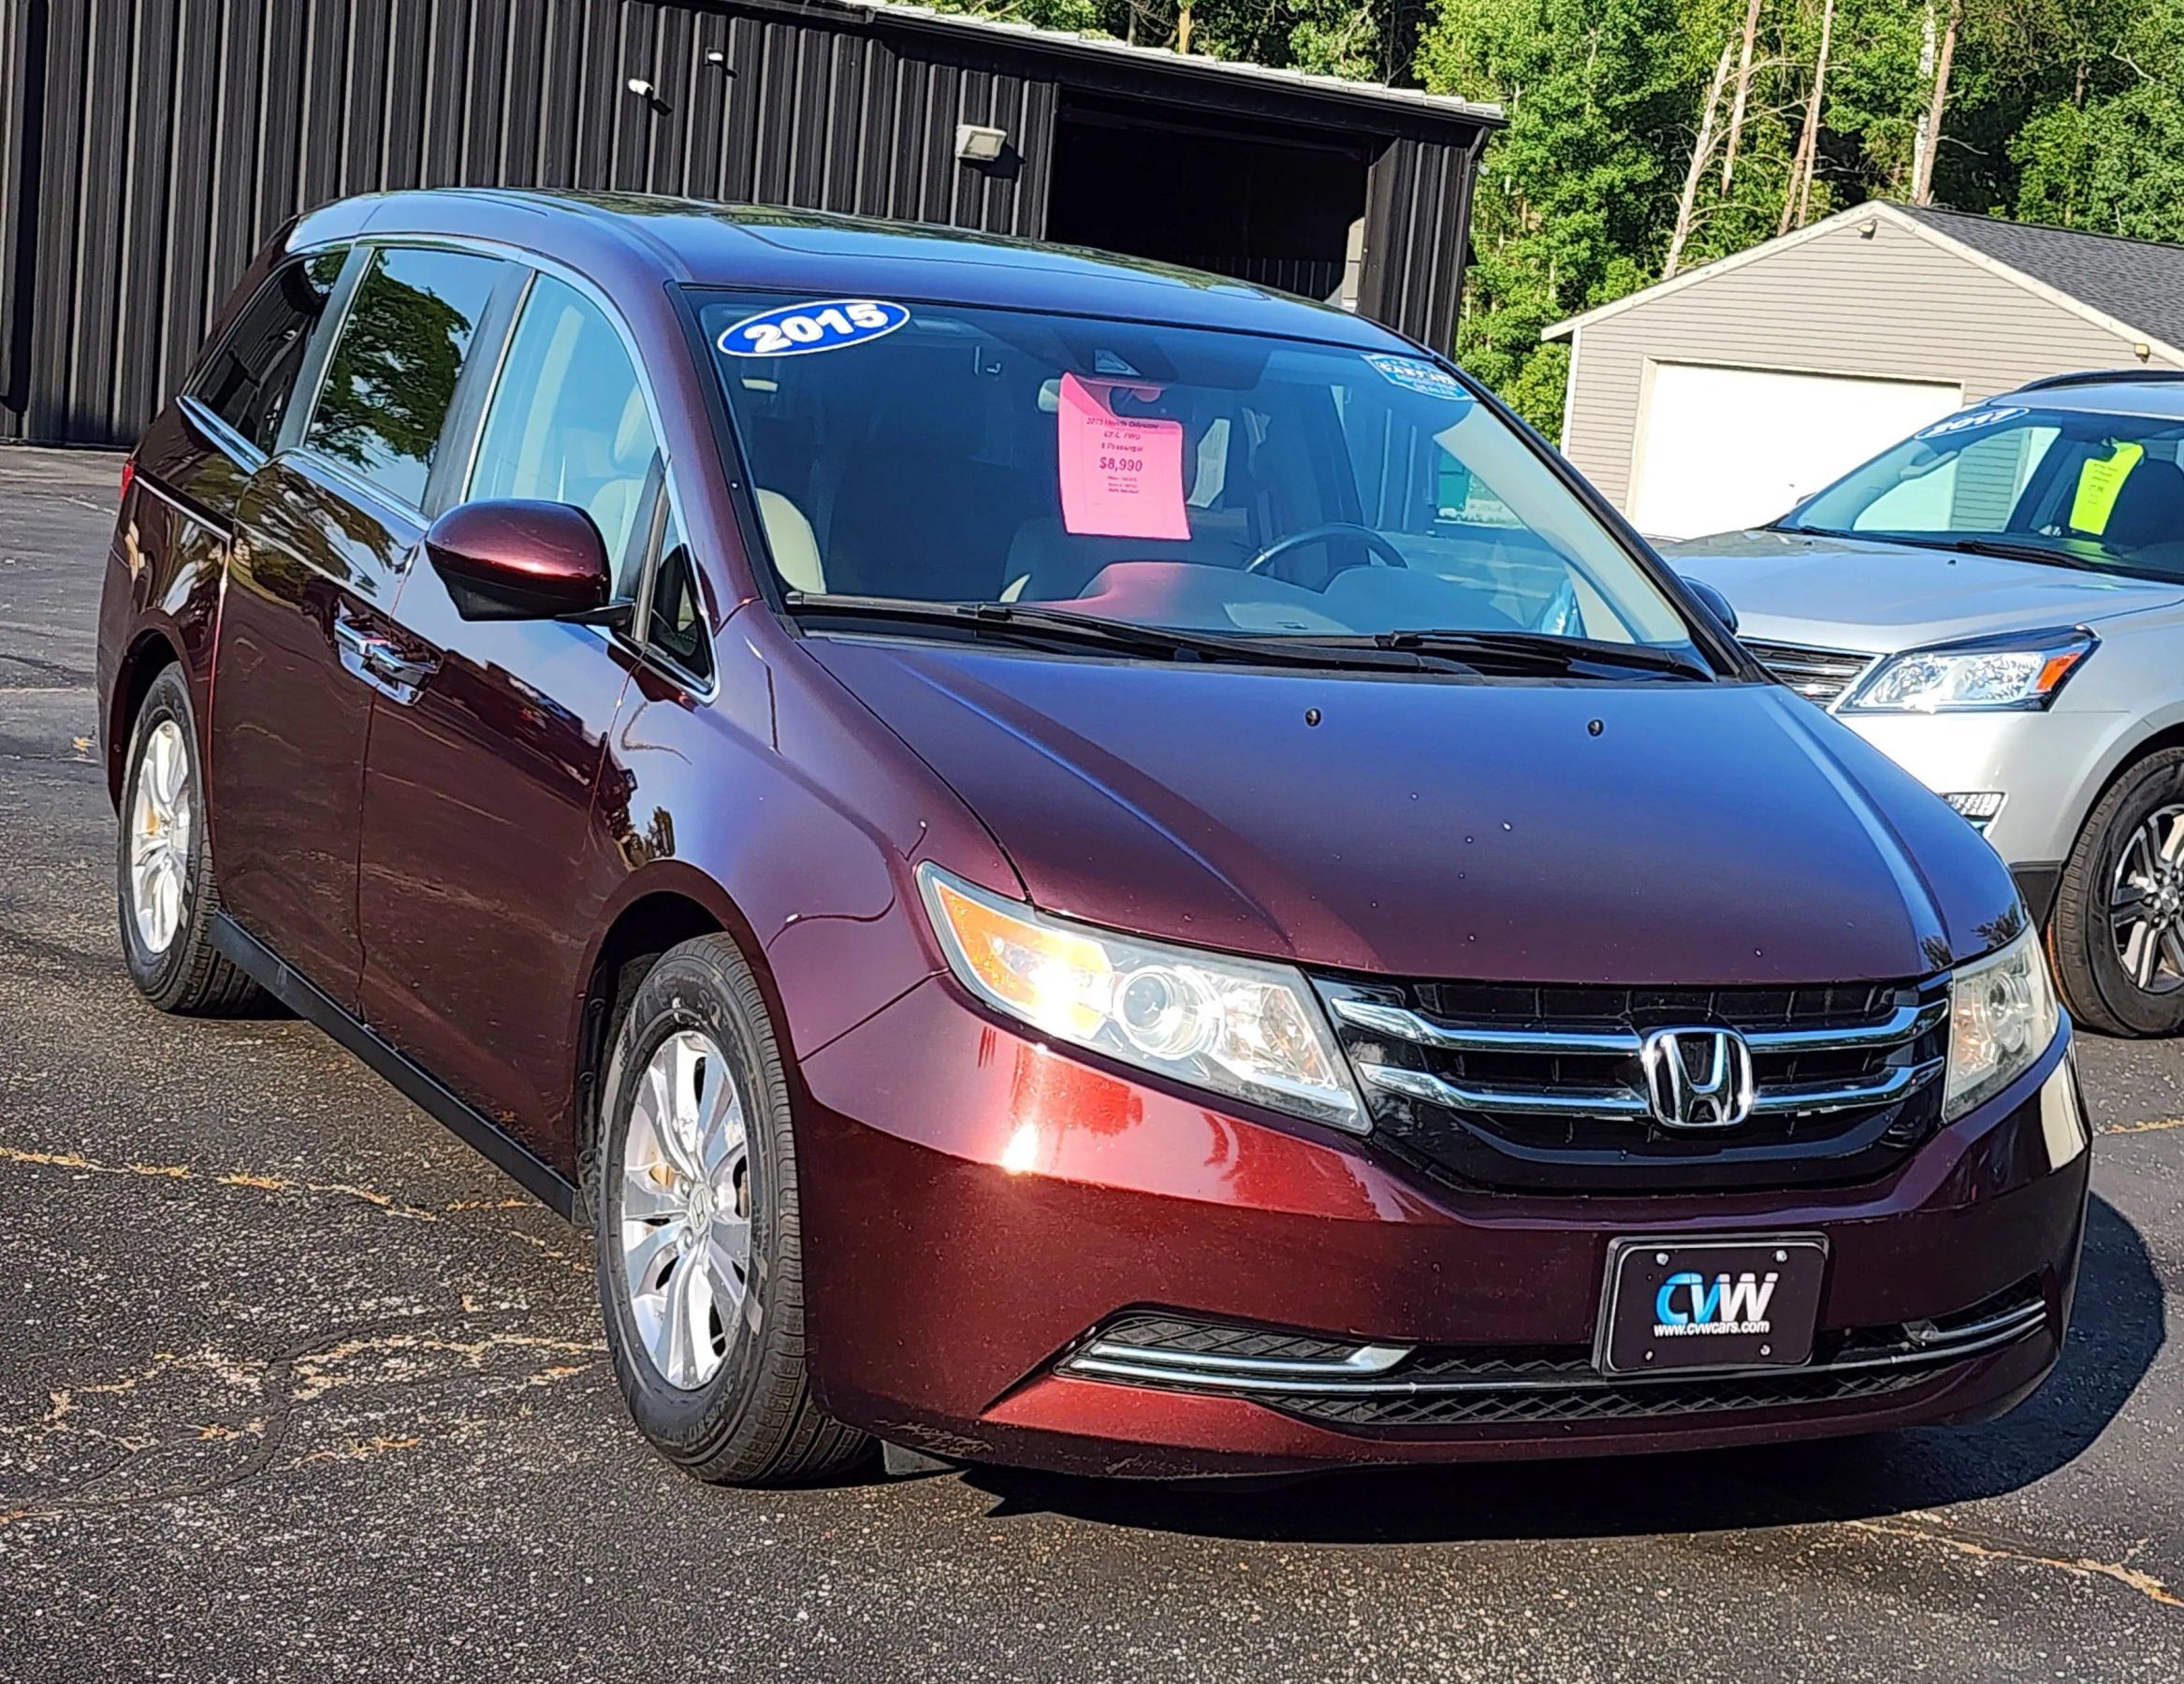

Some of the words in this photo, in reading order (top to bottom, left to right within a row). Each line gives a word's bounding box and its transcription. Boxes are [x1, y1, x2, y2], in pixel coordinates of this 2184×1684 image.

[743, 303, 889, 353] 2015
[1099, 457, 1143, 472] $8,990
[1656, 1272, 1779, 1324] CVW
[1653, 1320, 1769, 1337] www.cvwcars.com
